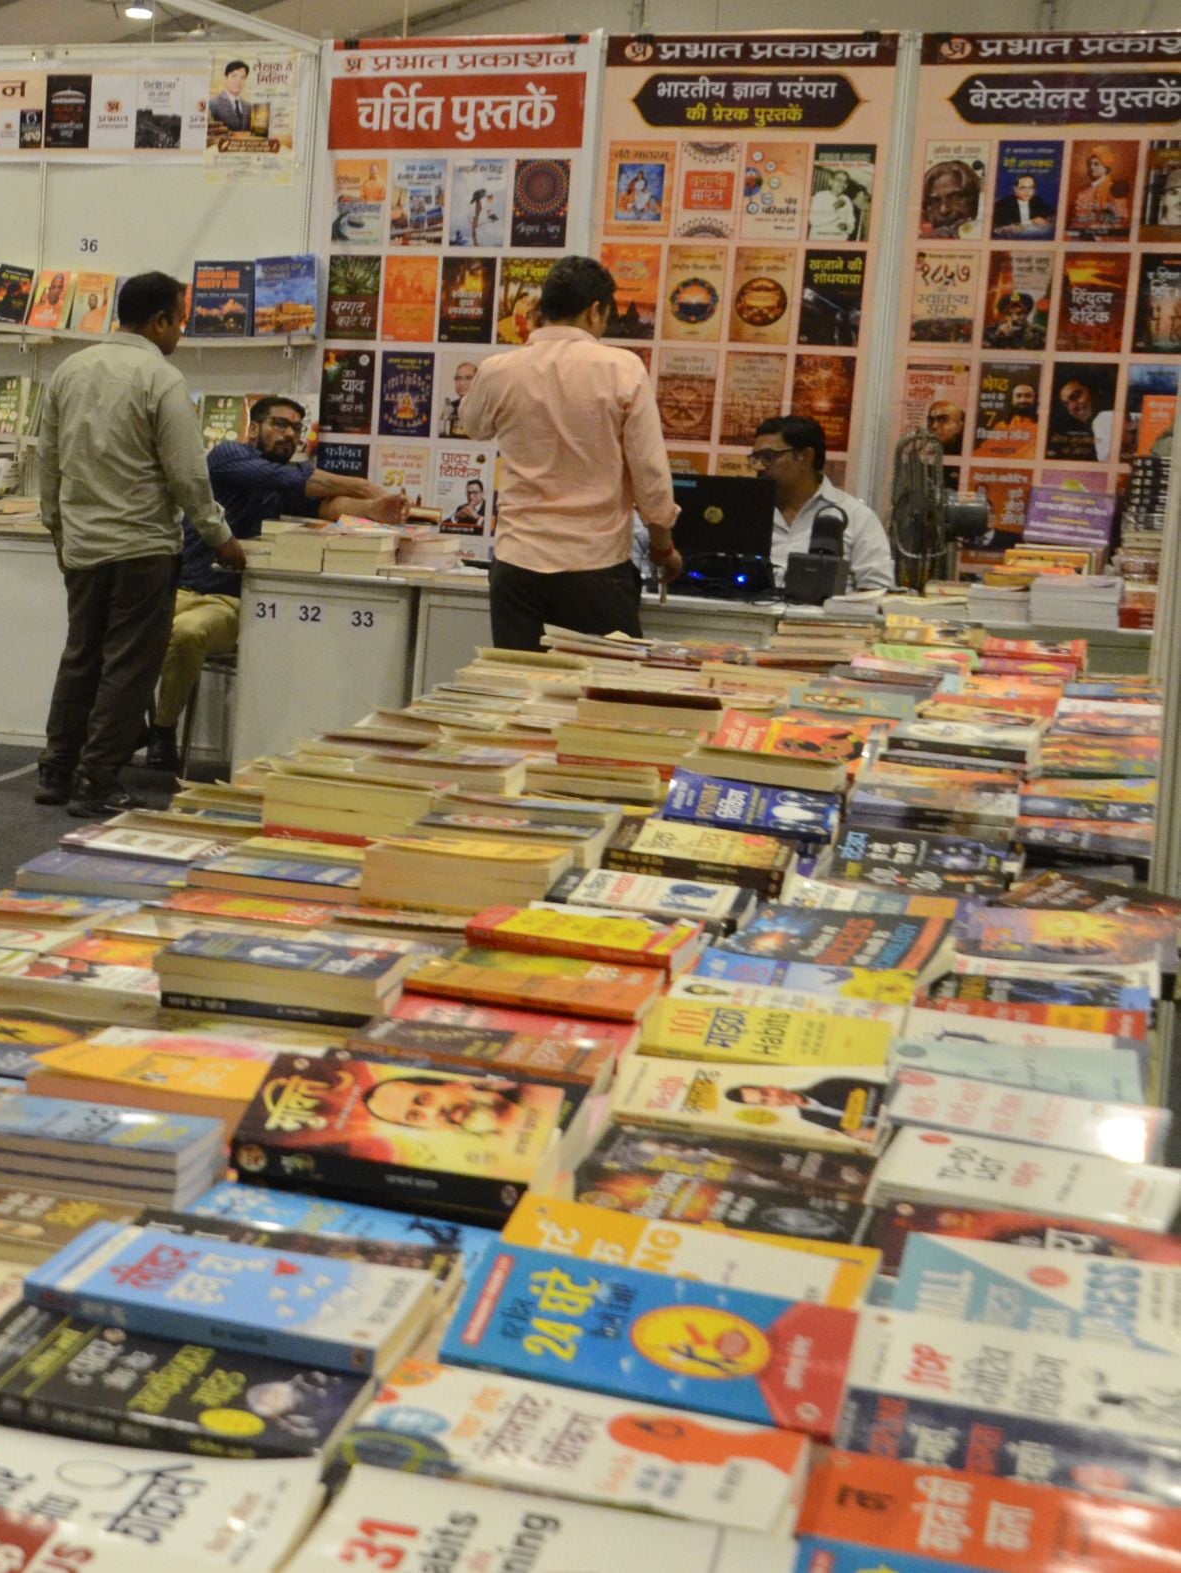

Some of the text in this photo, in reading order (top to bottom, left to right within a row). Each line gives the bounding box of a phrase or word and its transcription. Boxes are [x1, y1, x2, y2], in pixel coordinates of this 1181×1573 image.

[370, 55, 448, 71] प्रभात
[456, 51, 576, 70] प्रकाशन
[656, 42, 744, 60] प्रभात
[749, 41, 879, 59] प्रकाशन
[976, 37, 1073, 57] प्रभात
[1078, 37, 1181, 56] प्रकाश
[656, 76, 838, 100] भारतीय ज्ञान परंपरा
[969, 79, 1181, 118] बेस्टसेलर पुस्तकें
[356, 82, 558, 142] चर्चित पुस्तकें
[685, 102, 803, 127] की प्रेरक पुस्तकें
[80, 238, 98, 253] 36
[985, 411, 997, 427] 7
[256, 602, 374, 628] 31 32 33
[670, 1008, 711, 1037] 101
[750, 1012, 791, 1056] Habits
[938, 1145, 977, 1181] TO-DO
[531, 1267, 601, 1316] घंटे
[524, 1315, 584, 1361] 24
[905, 1343, 952, 1391] STOP
[339, 1516, 420, 1571] 31
[422, 1511, 478, 1573] abits
